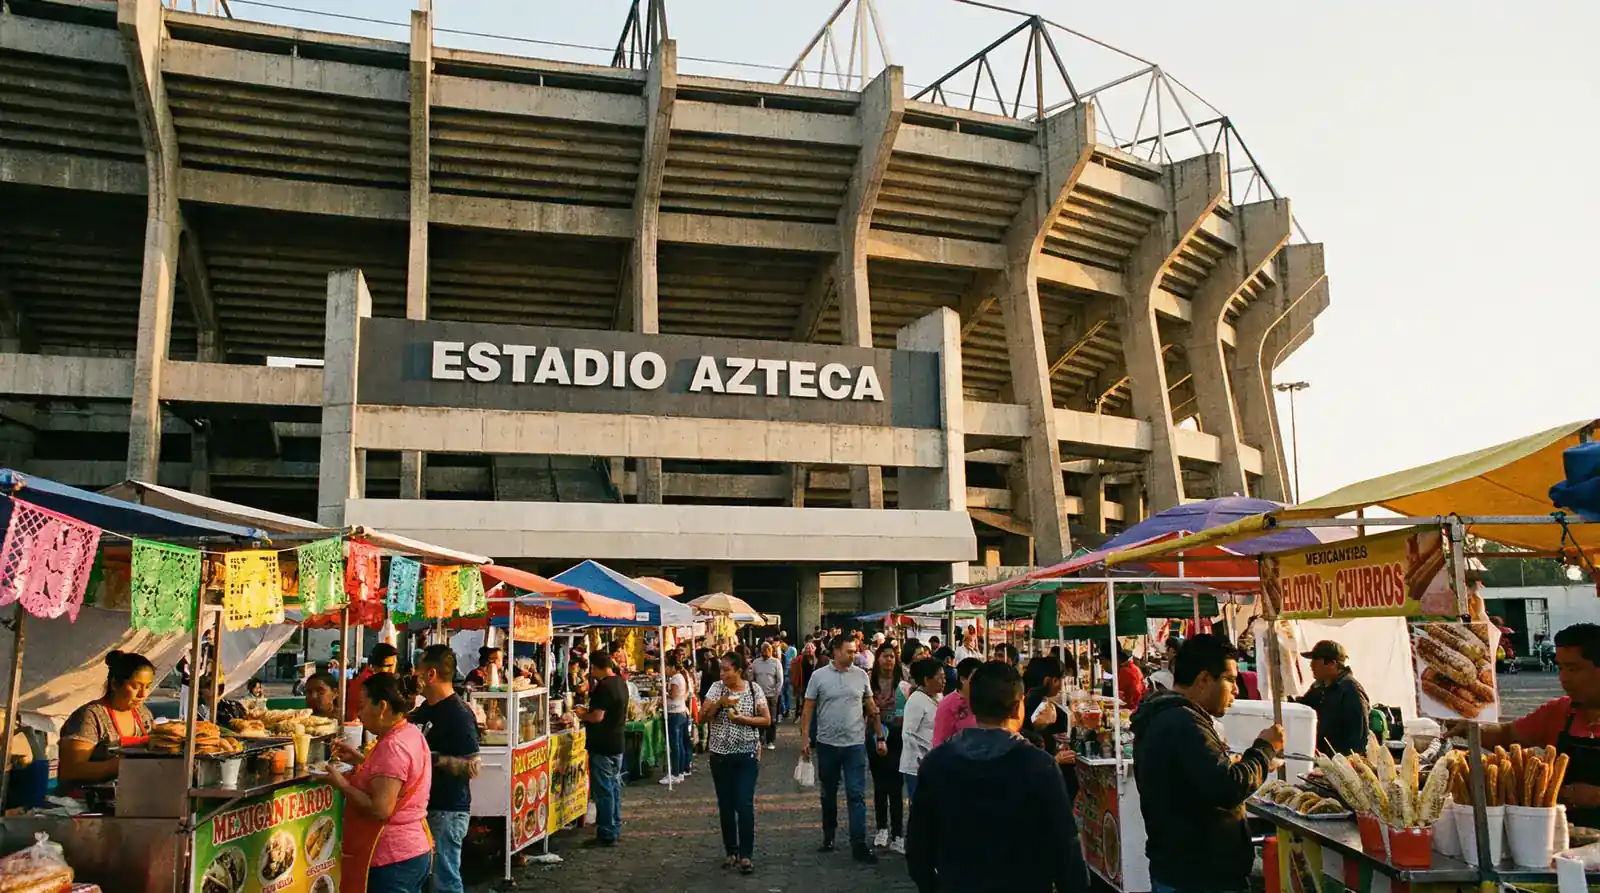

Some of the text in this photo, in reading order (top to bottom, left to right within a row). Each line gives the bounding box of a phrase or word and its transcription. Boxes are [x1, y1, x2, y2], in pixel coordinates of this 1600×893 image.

[432, 340, 885, 401] ESTADIO AZTECA
[1281, 563, 1405, 617] ELOTOS y CHURROS
